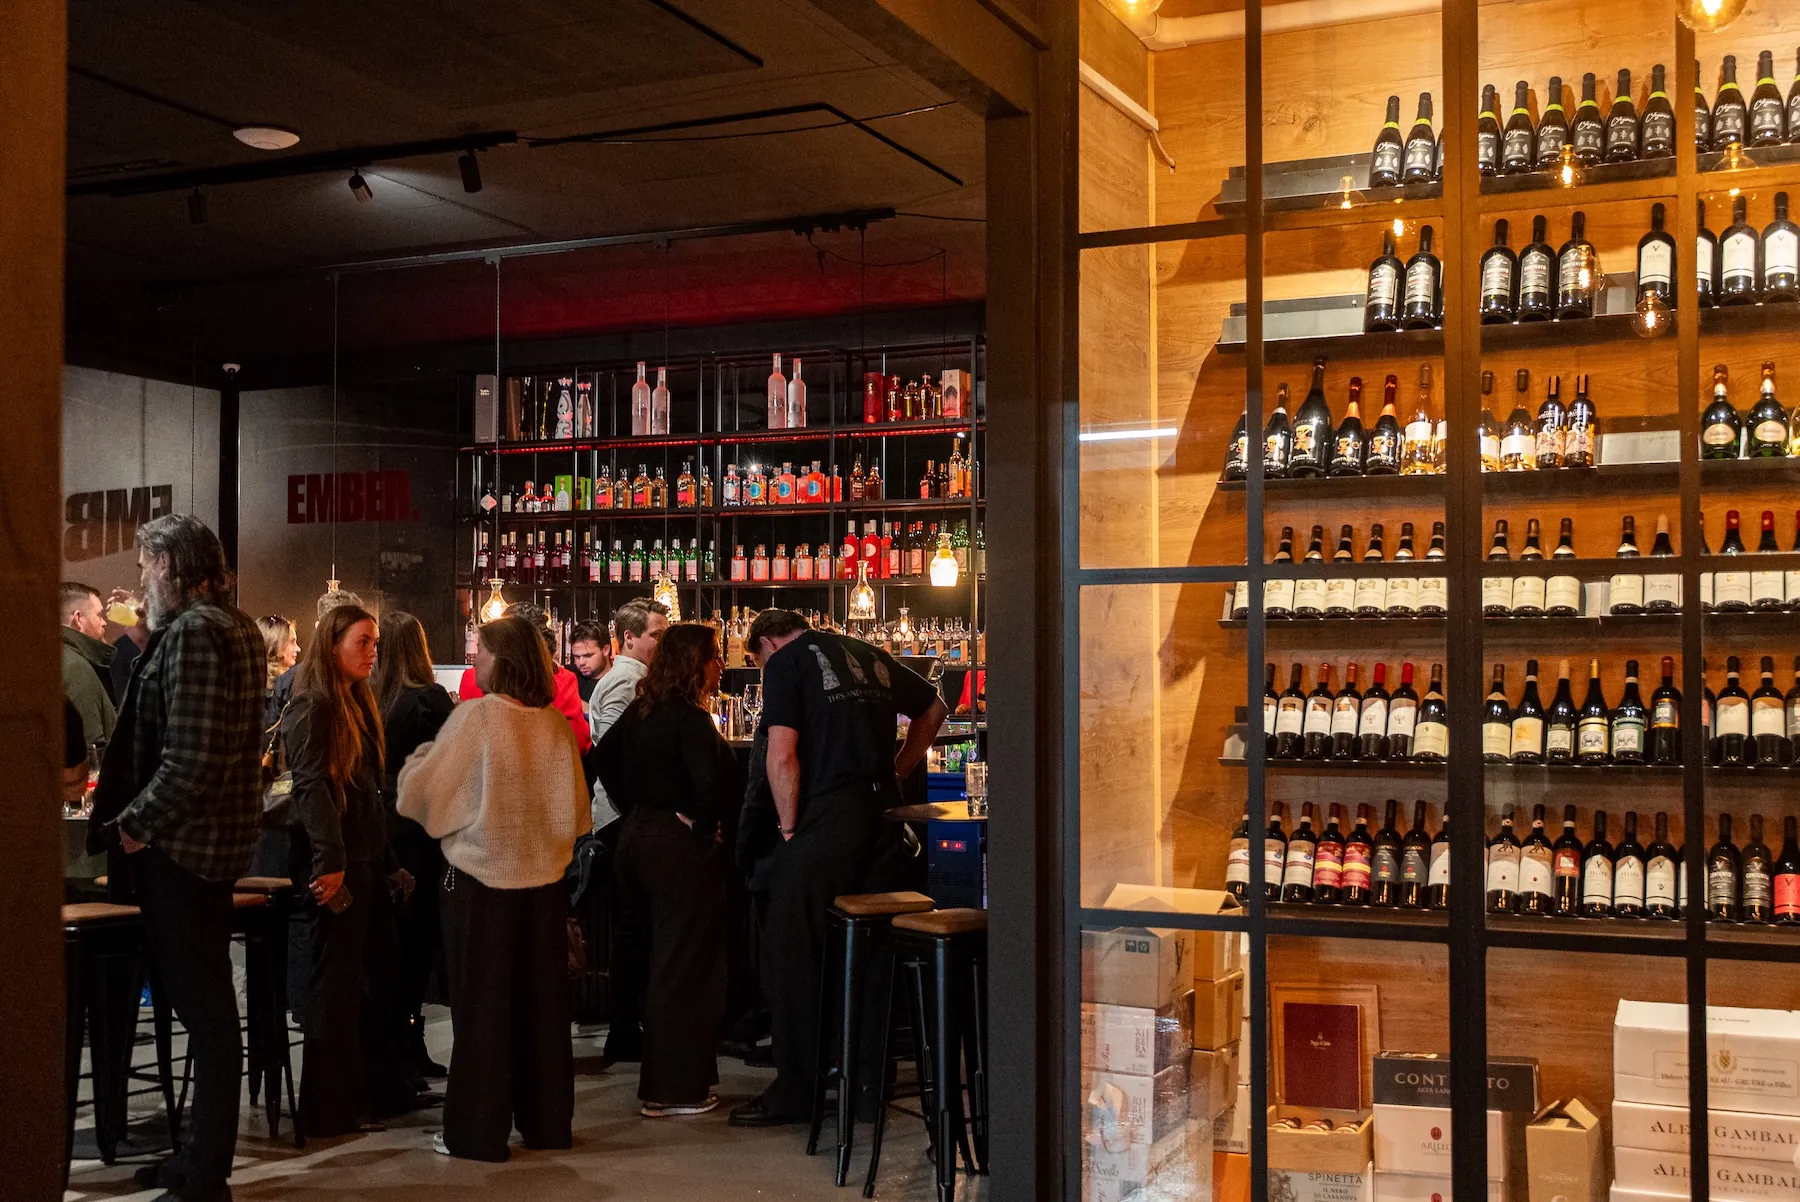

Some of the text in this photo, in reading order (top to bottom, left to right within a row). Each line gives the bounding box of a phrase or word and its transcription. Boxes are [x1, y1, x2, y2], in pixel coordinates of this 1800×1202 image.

[1650, 1121, 1690, 1135] ALE
[1653, 1163, 1690, 1178] ALE
[1308, 1172, 1363, 1185] SPINETTA
